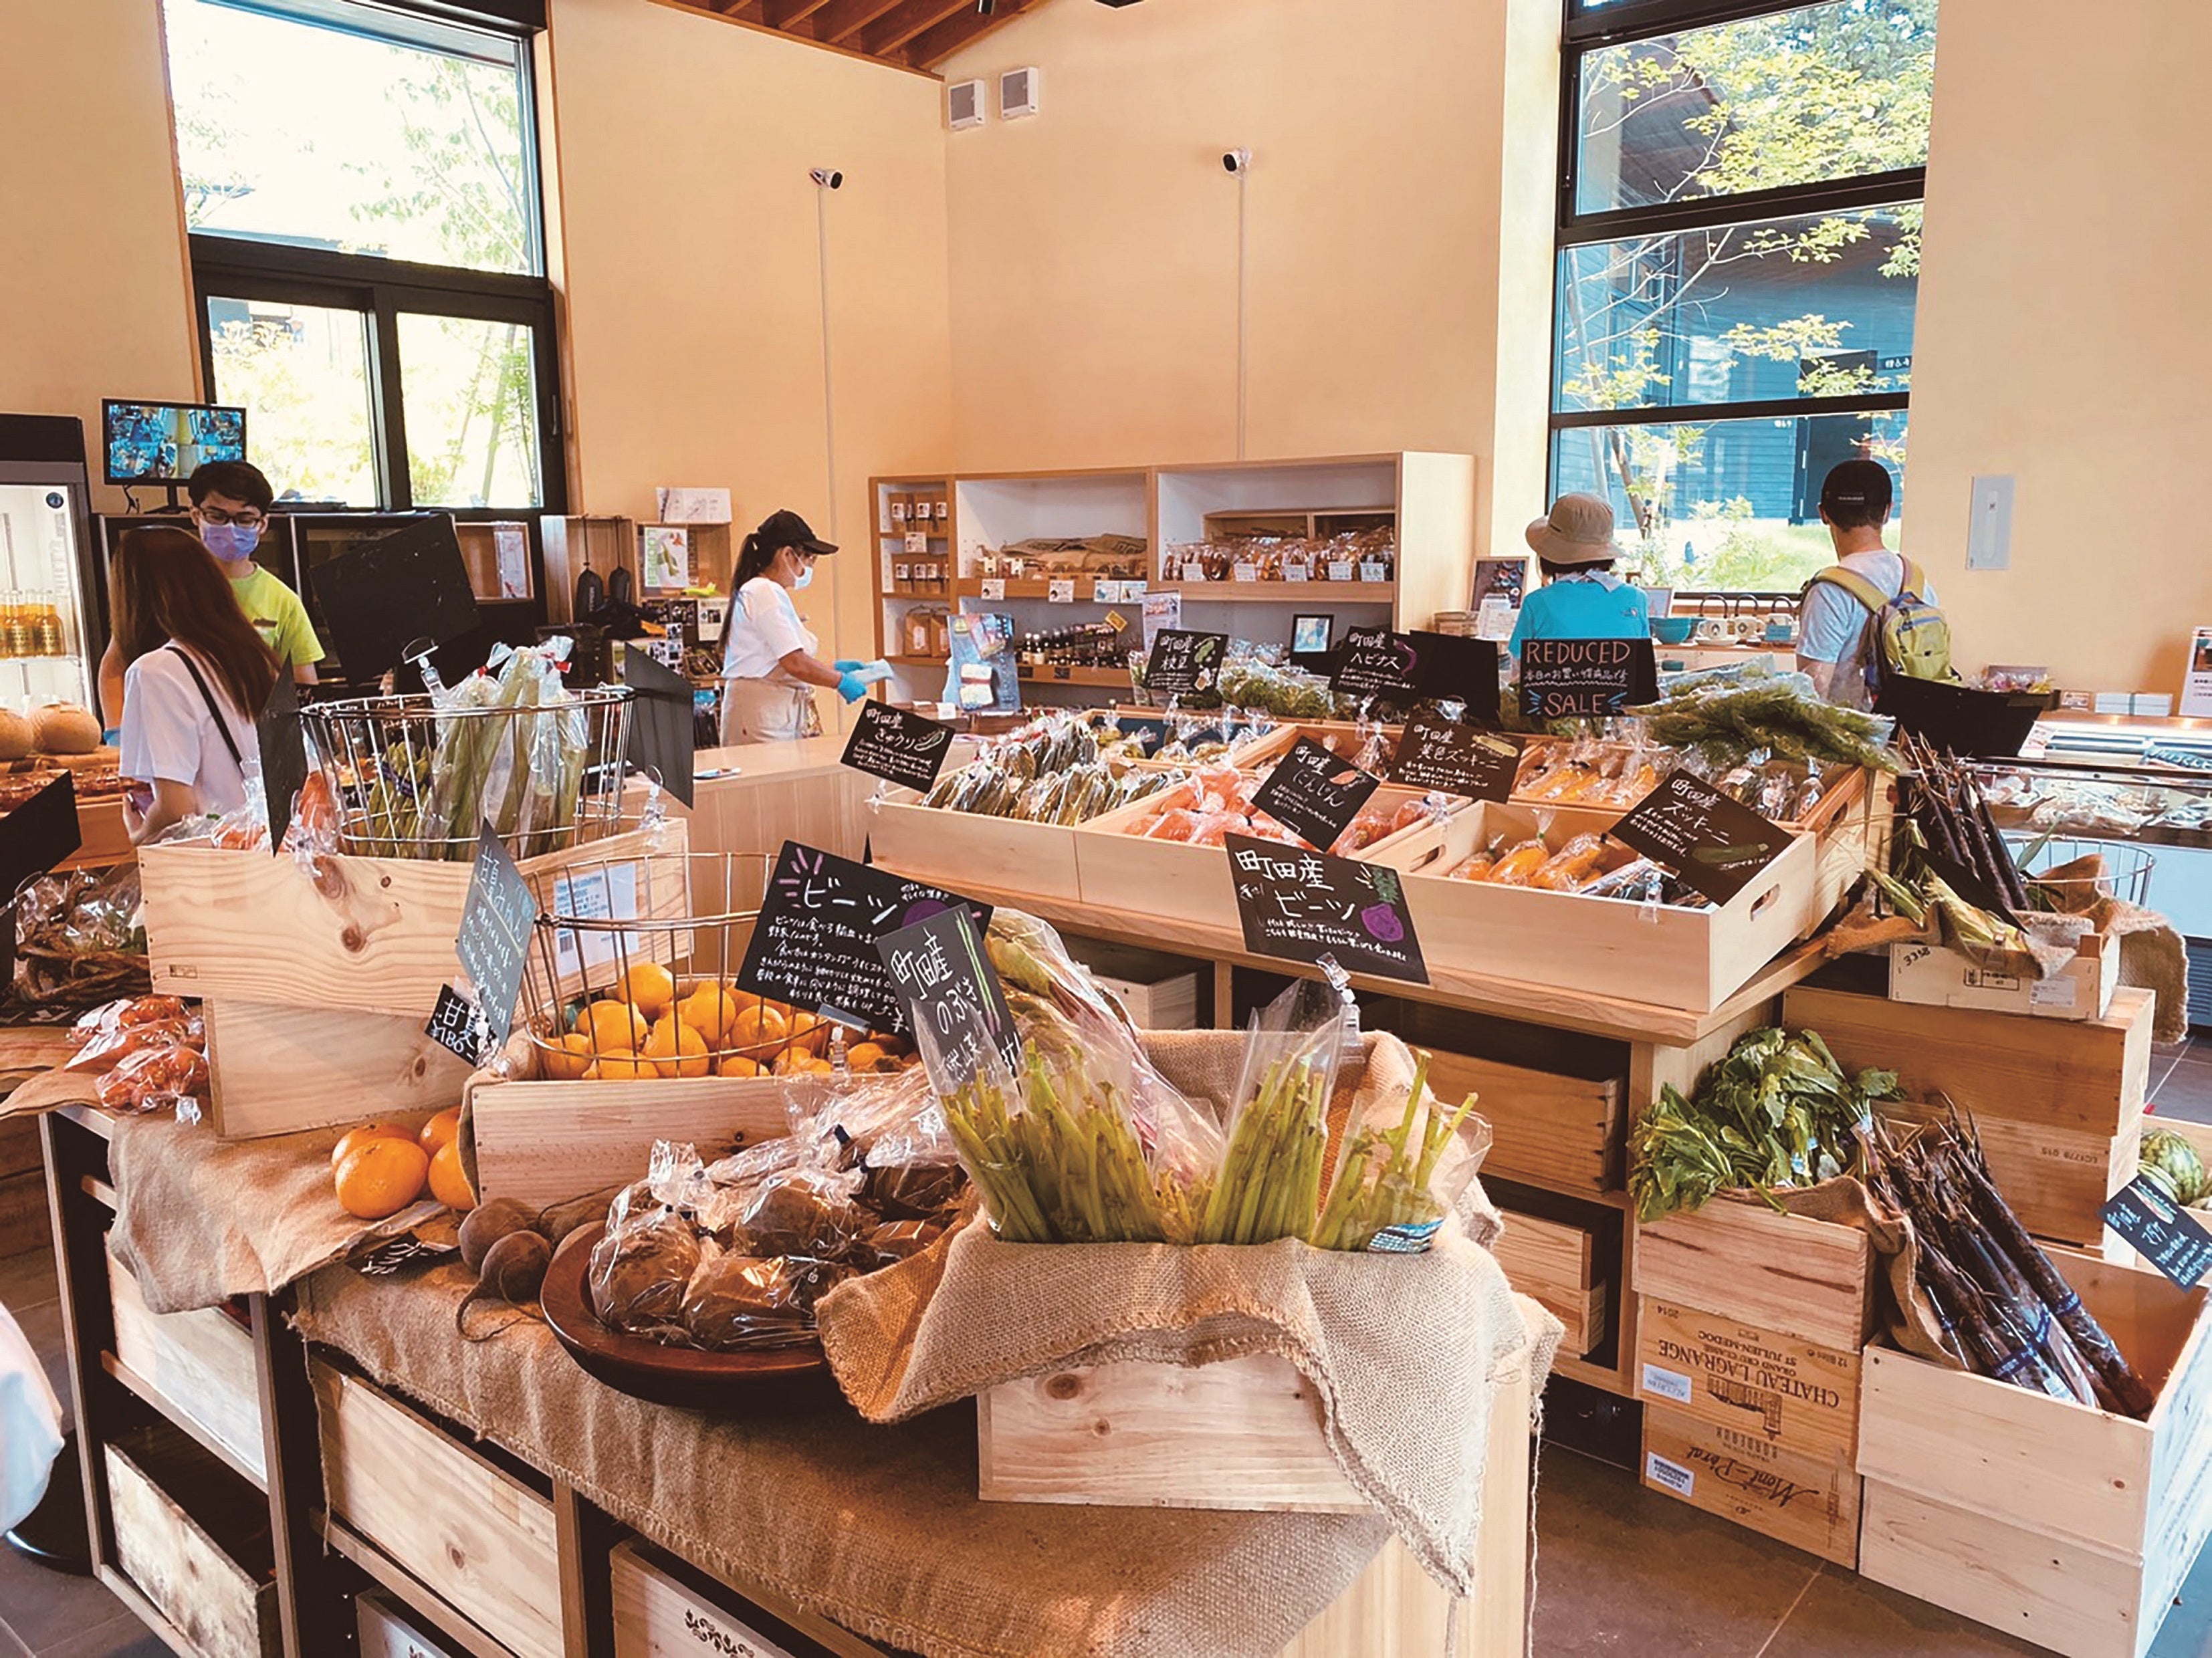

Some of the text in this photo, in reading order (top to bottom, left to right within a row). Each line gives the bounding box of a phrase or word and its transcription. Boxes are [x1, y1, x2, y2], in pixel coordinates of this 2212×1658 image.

[1526, 641, 1631, 665] REDUCED
[1544, 692, 1607, 717] SALE
[1414, 724, 1455, 744] 町田産
[1295, 745, 1332, 776] 町田産
[1416, 742, 1501, 770] 黄色ズッキーニ
[1292, 769, 1345, 808] にんじん
[1671, 778, 1721, 812] 町田産
[1662, 800, 1731, 846] ズッキーニ
[1235, 849, 1335, 891] 町田産
[803, 876, 898, 925] ビーツ
[1274, 890, 1356, 921] ビーツ
[890, 926, 955, 1001] 町田産
[1657, 1305, 1680, 1320] 2014
[1658, 1338, 1840, 1409] CHATEAU LAGRANGE
[1761, 1361, 1797, 1377] GRAND
[1837, 1356, 1848, 1369] 12
